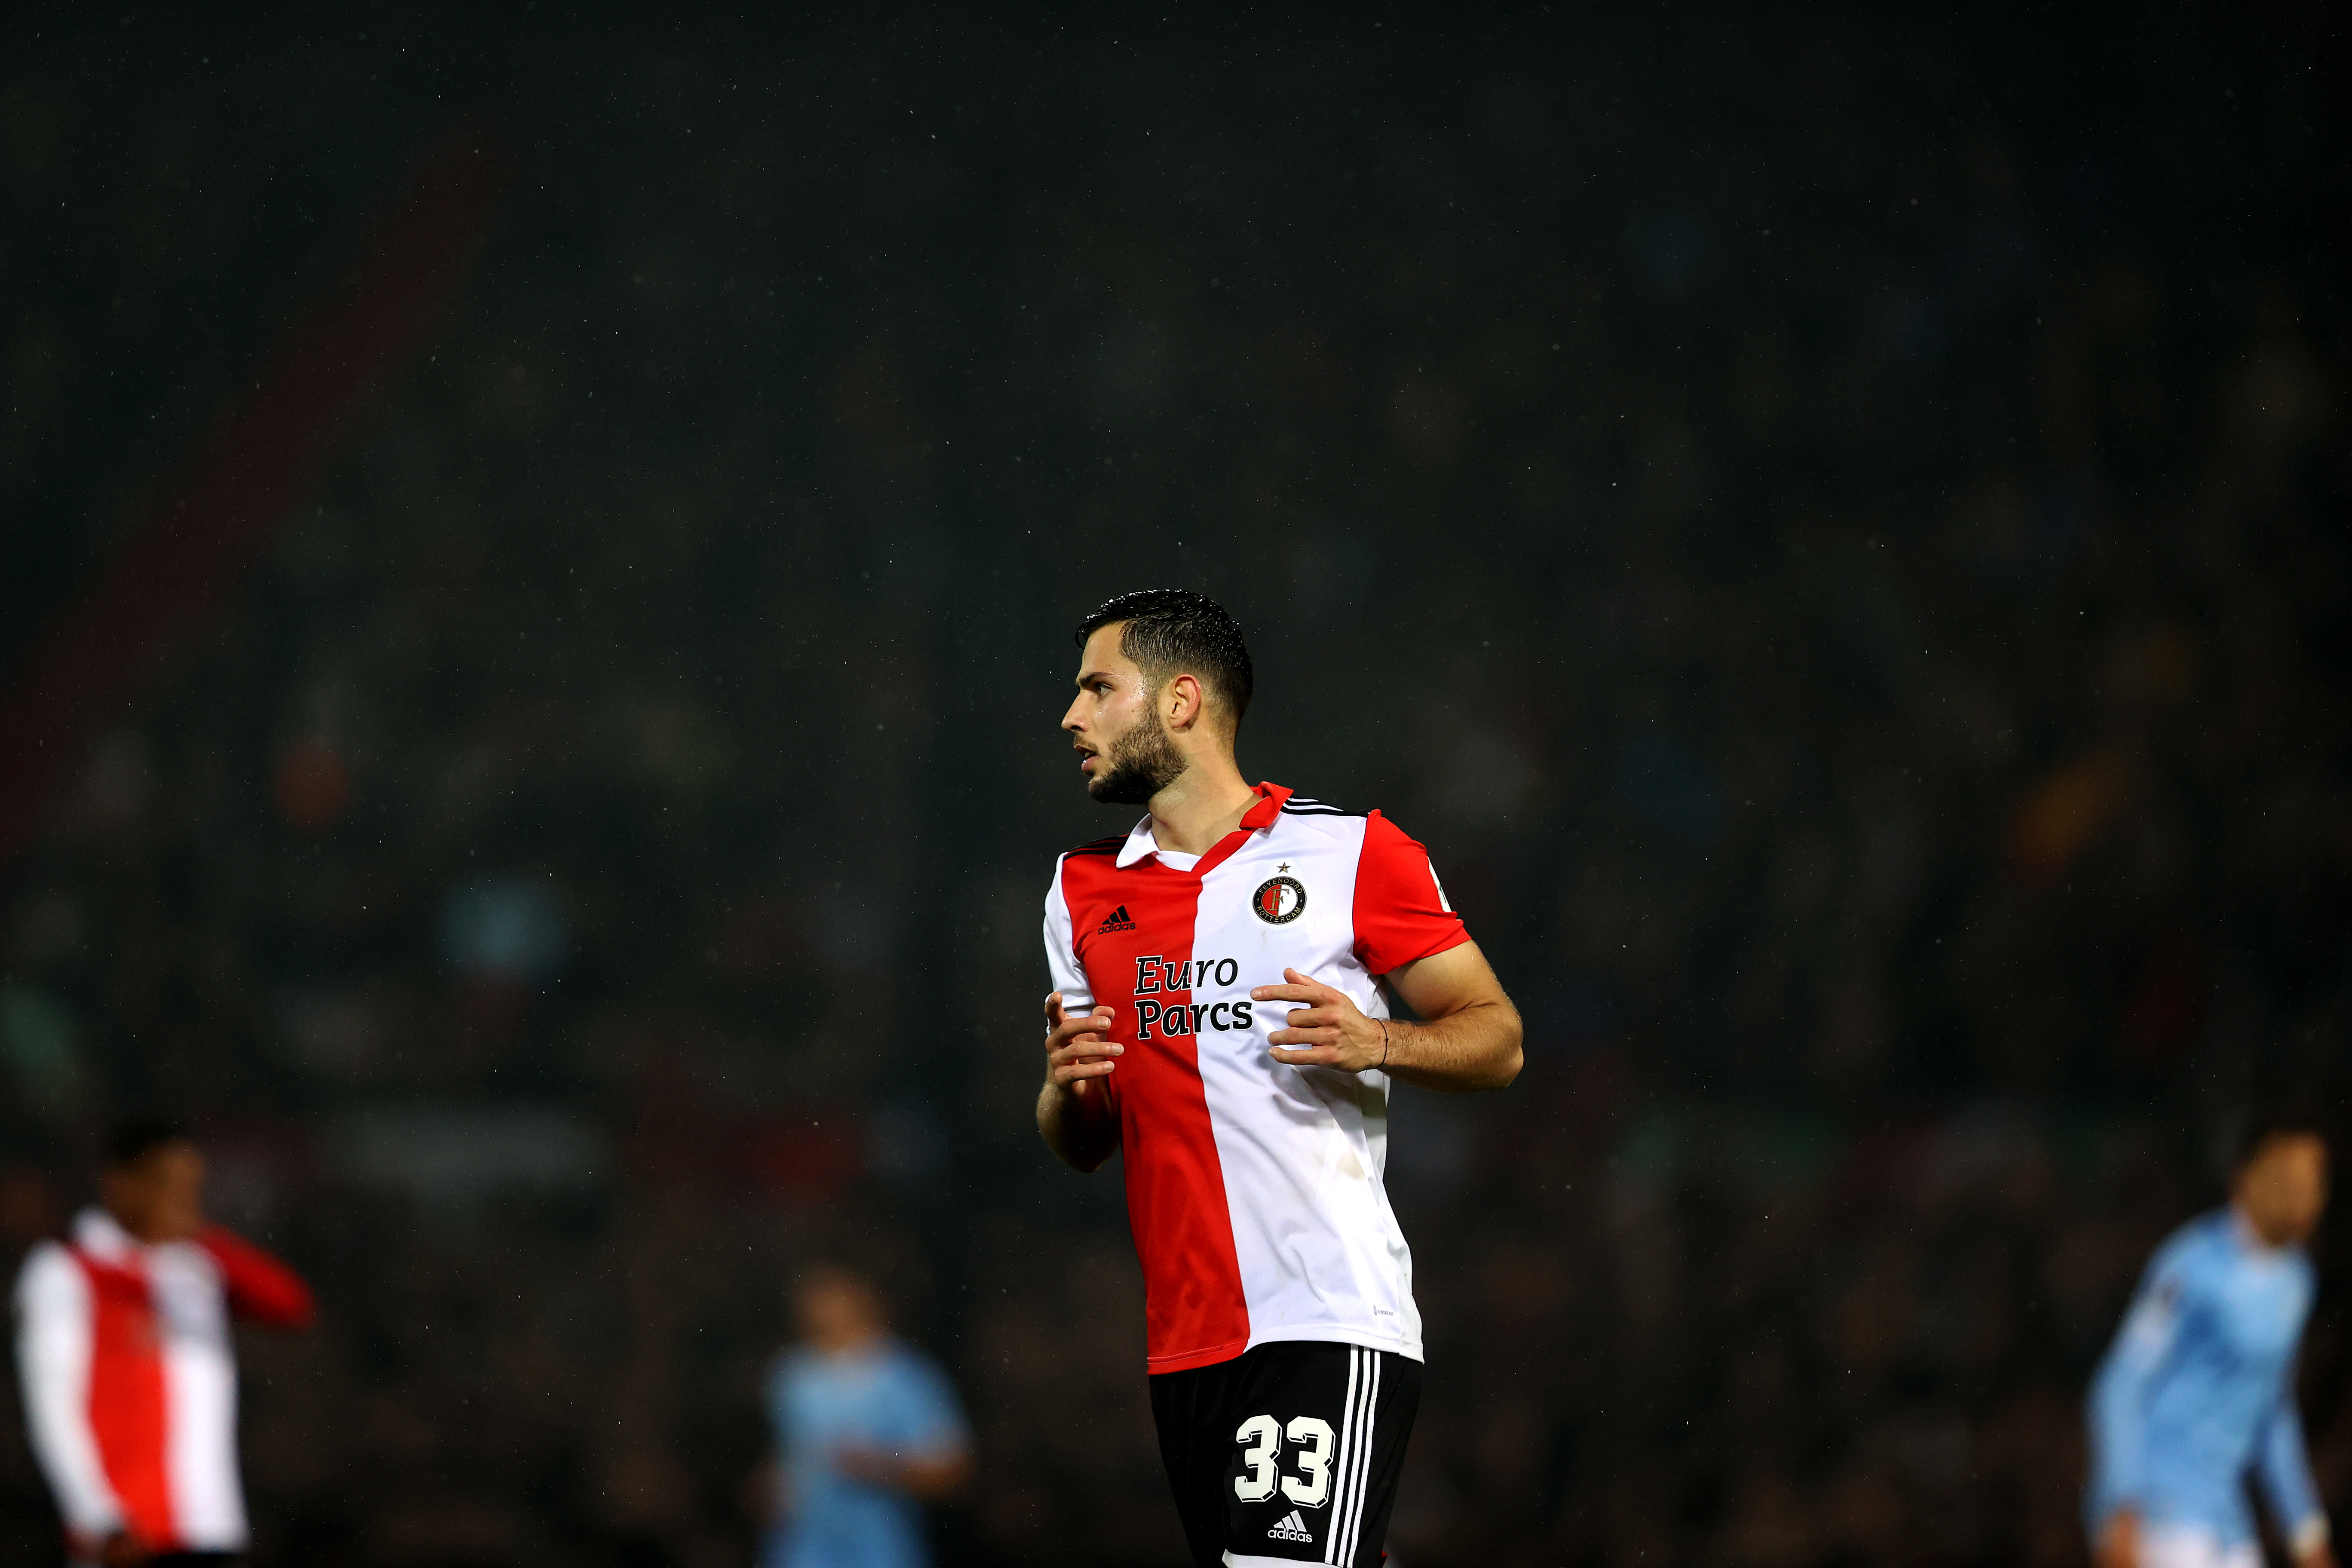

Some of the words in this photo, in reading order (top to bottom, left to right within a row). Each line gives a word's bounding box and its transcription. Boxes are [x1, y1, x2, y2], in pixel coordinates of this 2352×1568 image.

[1259, 878, 1303, 894] FEYENOORD
[1268, 888, 1290, 911] F
[1256, 906, 1302, 922] ROTTERDAM
[1098, 922, 1136, 935] adidas
[1134, 955, 1238, 995] Euro
[1135, 999, 1253, 1040] Parcs
[1235, 1415, 1336, 1509] 33
[1268, 1528, 1313, 1543] adidas
